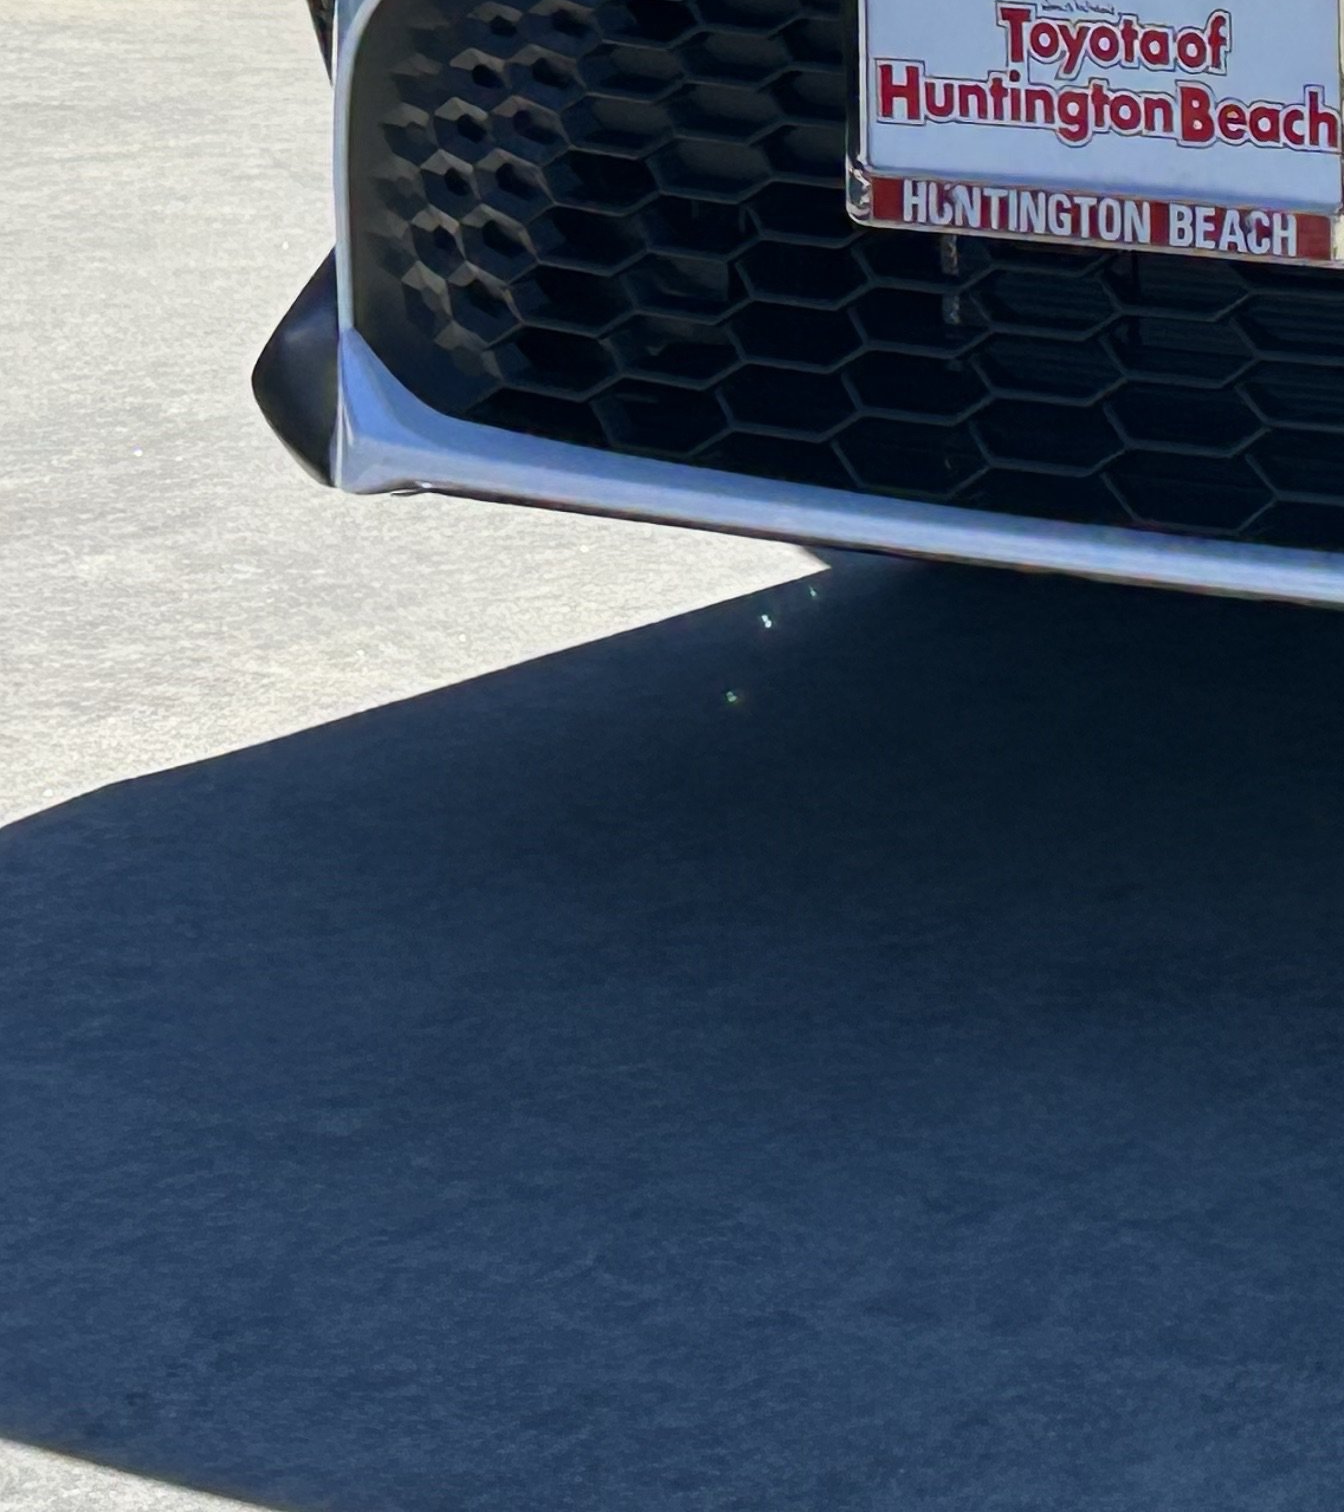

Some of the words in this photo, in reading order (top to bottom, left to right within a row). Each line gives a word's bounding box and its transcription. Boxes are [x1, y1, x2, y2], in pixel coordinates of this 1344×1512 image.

[999, 6, 1171, 76] Toyota
[1176, 12, 1230, 70] of
[878, 63, 1175, 142] Huntington
[1179, 85, 1339, 148] Beach
[902, 178, 1151, 245] HUNTINGTON
[1168, 202, 1299, 258] BEACH
